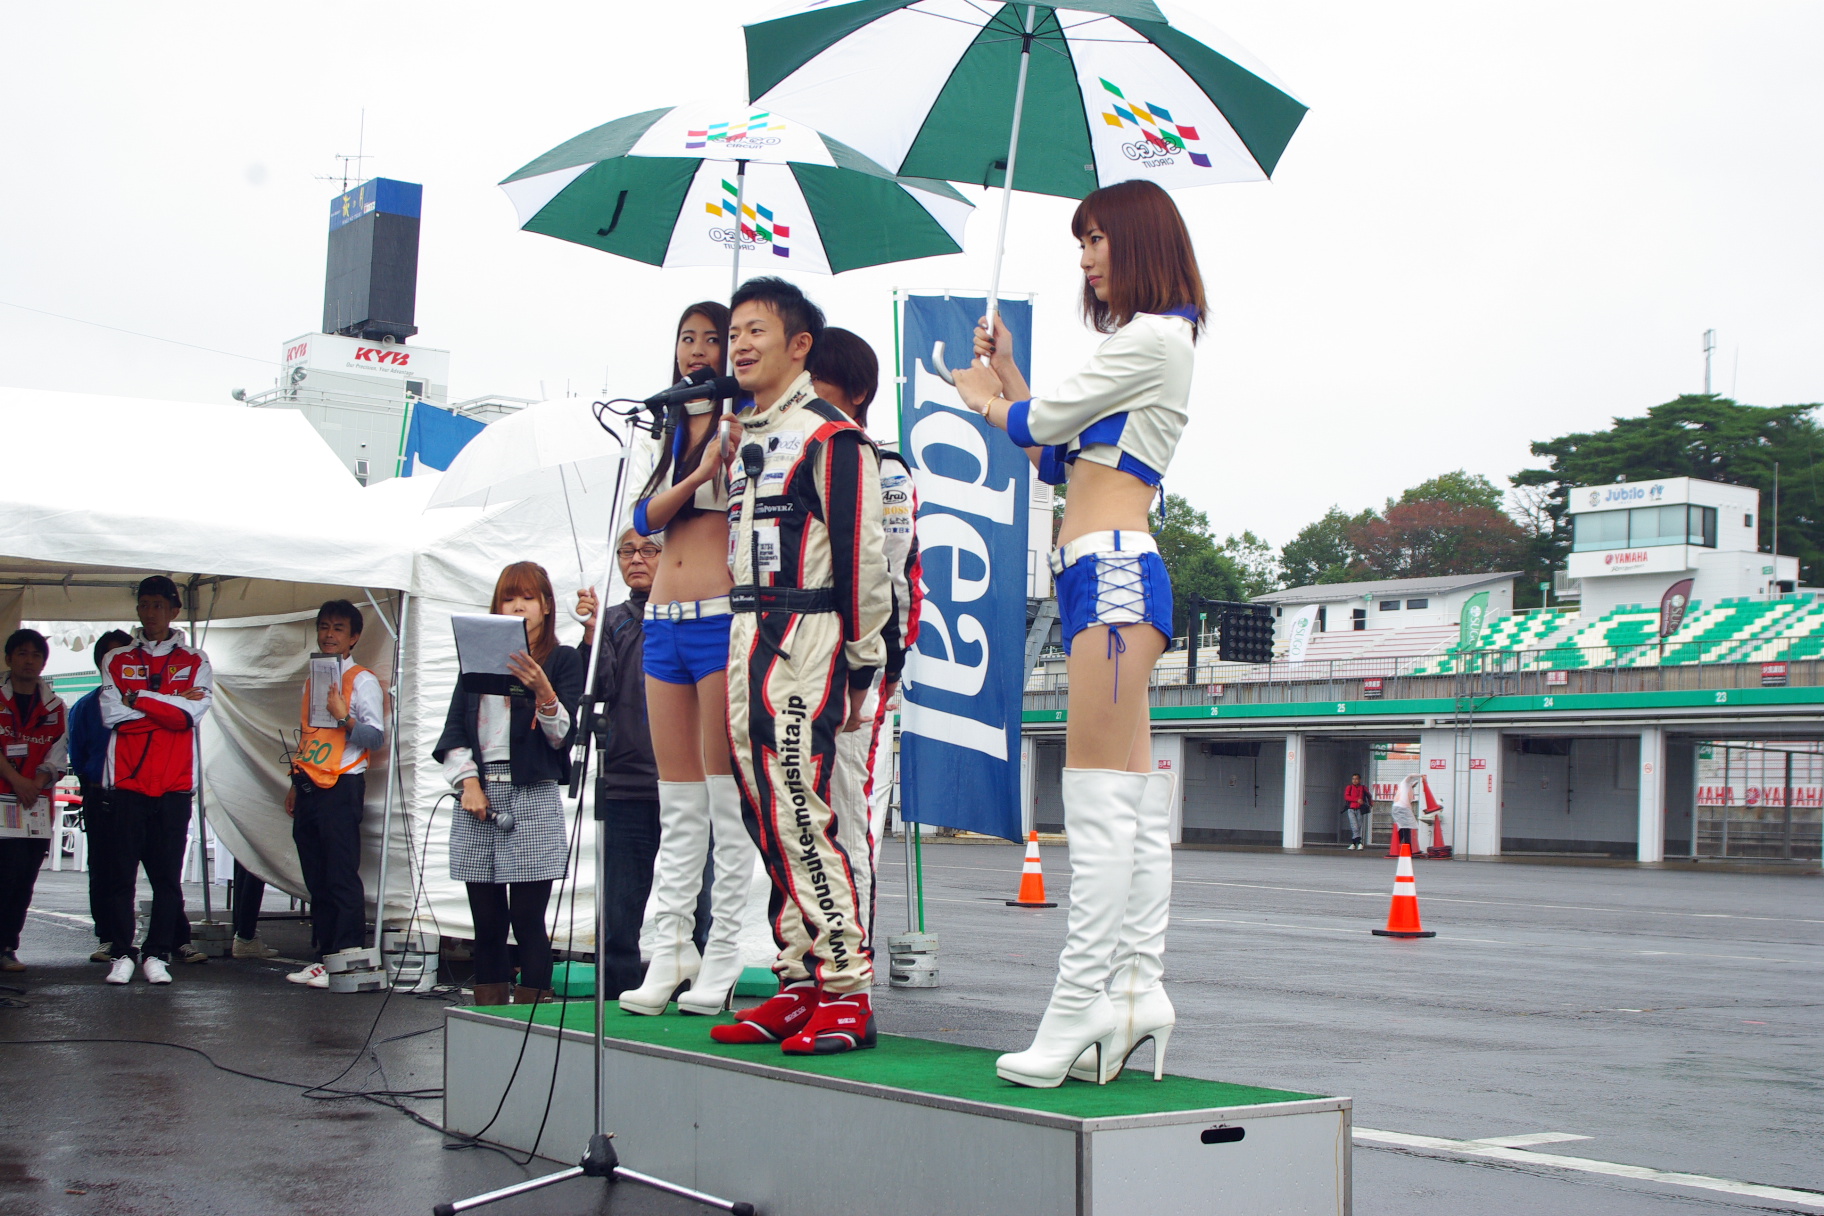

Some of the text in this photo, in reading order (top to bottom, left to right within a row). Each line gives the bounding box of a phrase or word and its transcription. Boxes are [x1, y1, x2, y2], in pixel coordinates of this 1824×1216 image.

[287, 343, 307, 362] KYB
[355, 347, 410, 366] KYB
[1614, 551, 1648, 564] YAMAHA
[1291, 628, 1306, 656] SUGO
[1543, 697, 1554, 707] 24
[1715, 692, 1727, 702] 23
[1210, 707, 1218, 716] 26
[1337, 703, 1345, 713] 25
[1055, 711, 1062, 720] 27
[1762, 786, 1823, 806] YAAHA
[781, 695, 849, 972] www.yousuke-morishita.jp
